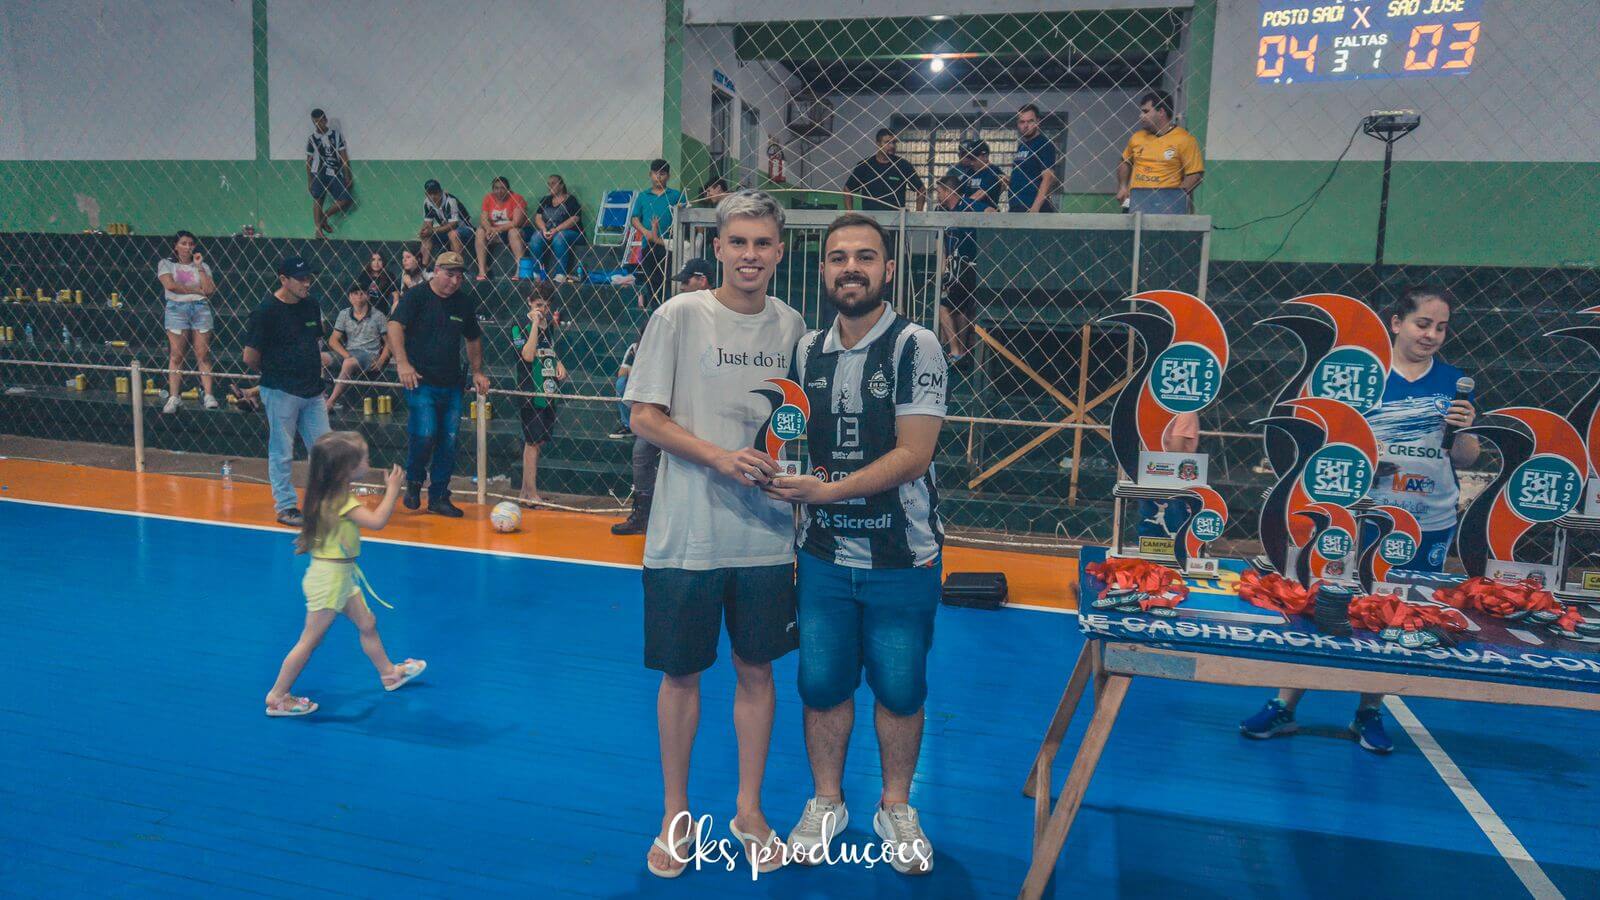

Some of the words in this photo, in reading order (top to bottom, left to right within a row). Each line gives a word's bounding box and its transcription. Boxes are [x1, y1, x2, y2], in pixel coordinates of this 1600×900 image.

[1262, 9, 1309, 27] POSTO
[1351, 6, 1371, 29] X
[1334, 34, 1388, 47] FALTAS
[1404, 21, 1480, 70] 03
[1256, 34, 1318, 77] 04
[716, 347, 749, 367] Just
[753, 352, 774, 367] do
[917, 373, 943, 388] CM
[1159, 376, 1203, 396] SAL
[1320, 382, 1366, 401] SAL
[1388, 444, 1443, 460] CRESOL
[1313, 475, 1354, 493] SAL
[1518, 486, 1561, 506] SAL
[833, 513, 892, 529] Sicredi
[1121, 616, 1342, 650] CASHBACK
